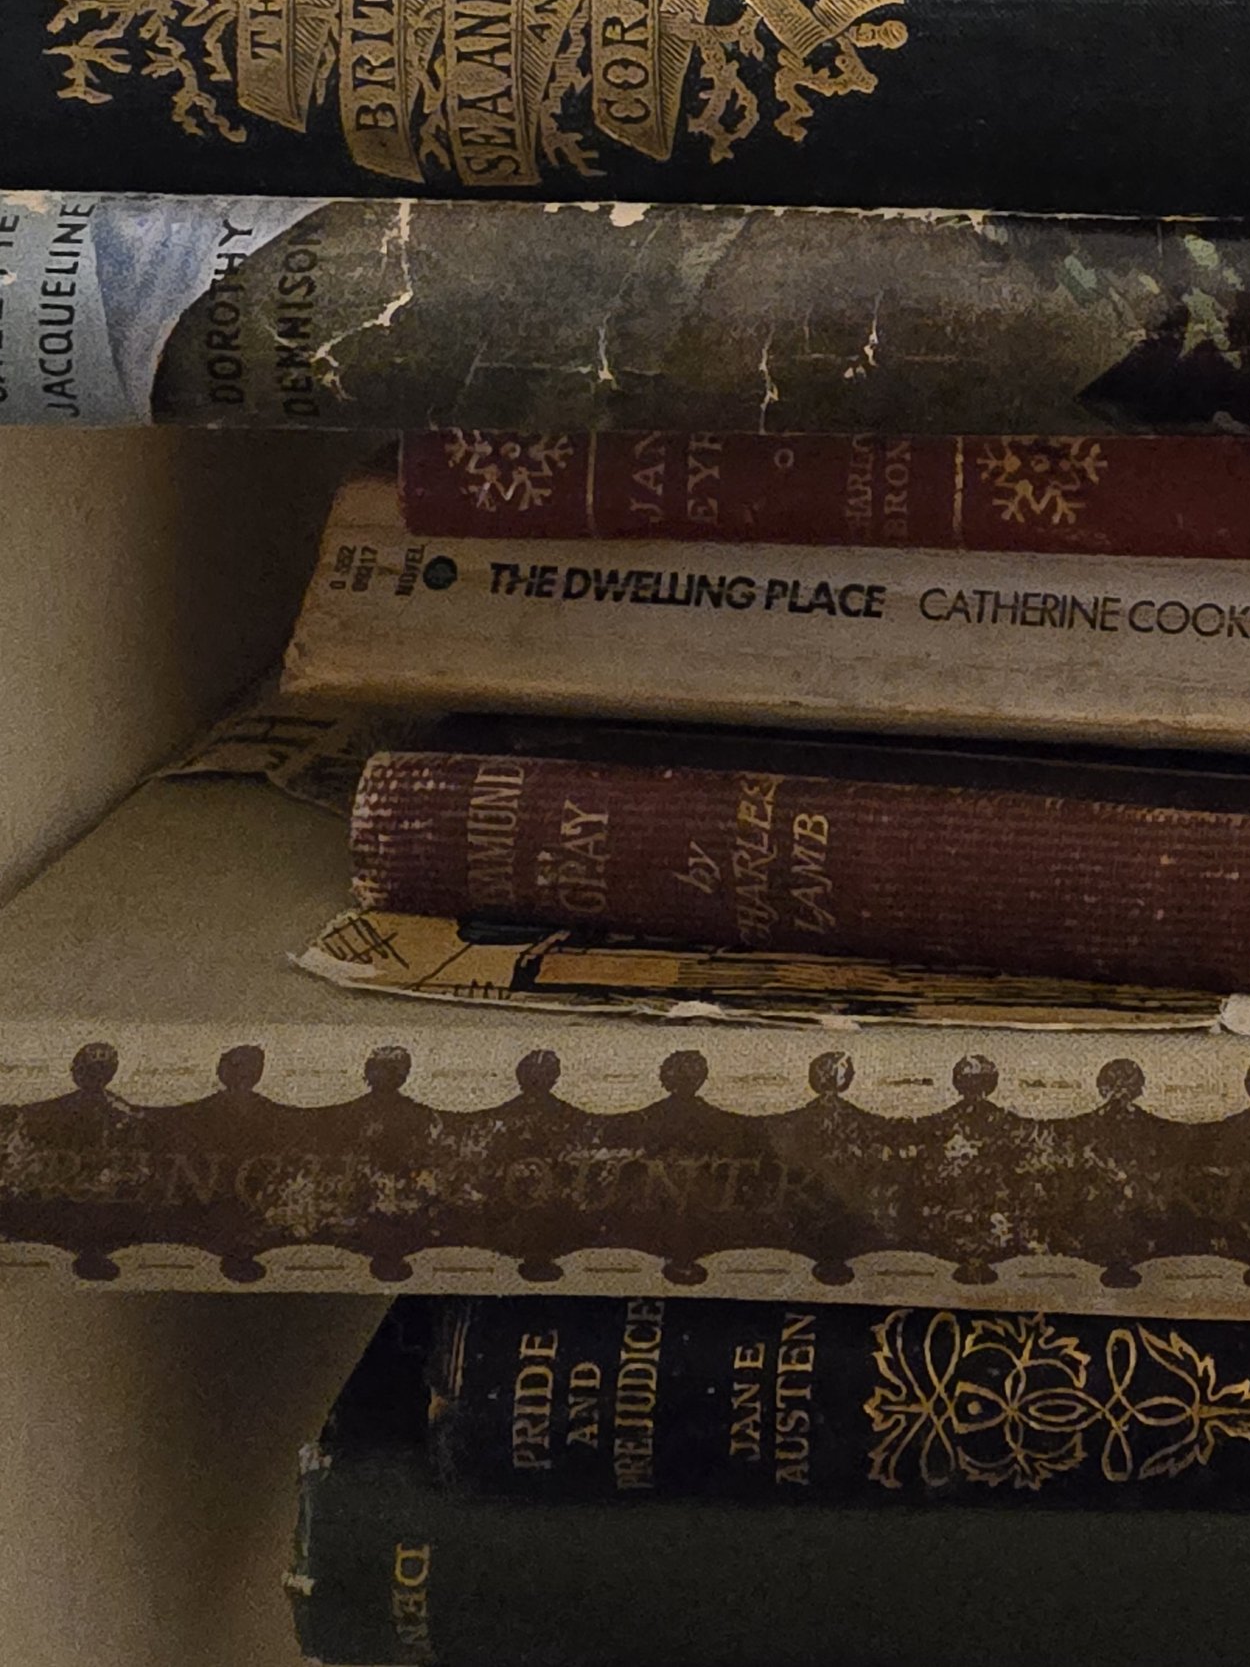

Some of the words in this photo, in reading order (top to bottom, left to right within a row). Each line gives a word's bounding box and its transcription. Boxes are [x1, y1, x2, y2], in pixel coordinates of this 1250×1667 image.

[458, 90, 520, 179] SEA
[38, 201, 95, 418] JACQUELINE
[205, 218, 254, 406] DOROTHY
[629, 431, 666, 524] JAN
[882, 433, 912, 537] BRON
[490, 561, 558, 600] THE
[562, 563, 756, 611] DWELLING
[765, 577, 887, 619] PLACE
[918, 585, 1123, 633] CATHERINE
[558, 797, 611, 914] GRAY
[789, 812, 836, 935] LAMB
[512, 1328, 559, 1471] PRIDE
[565, 1361, 602, 1450] AND
[612, 1298, 666, 1491] PREJUDICE
[729, 1340, 766, 1461] JANE
[773, 1310, 817, 1487] AUSTEN
